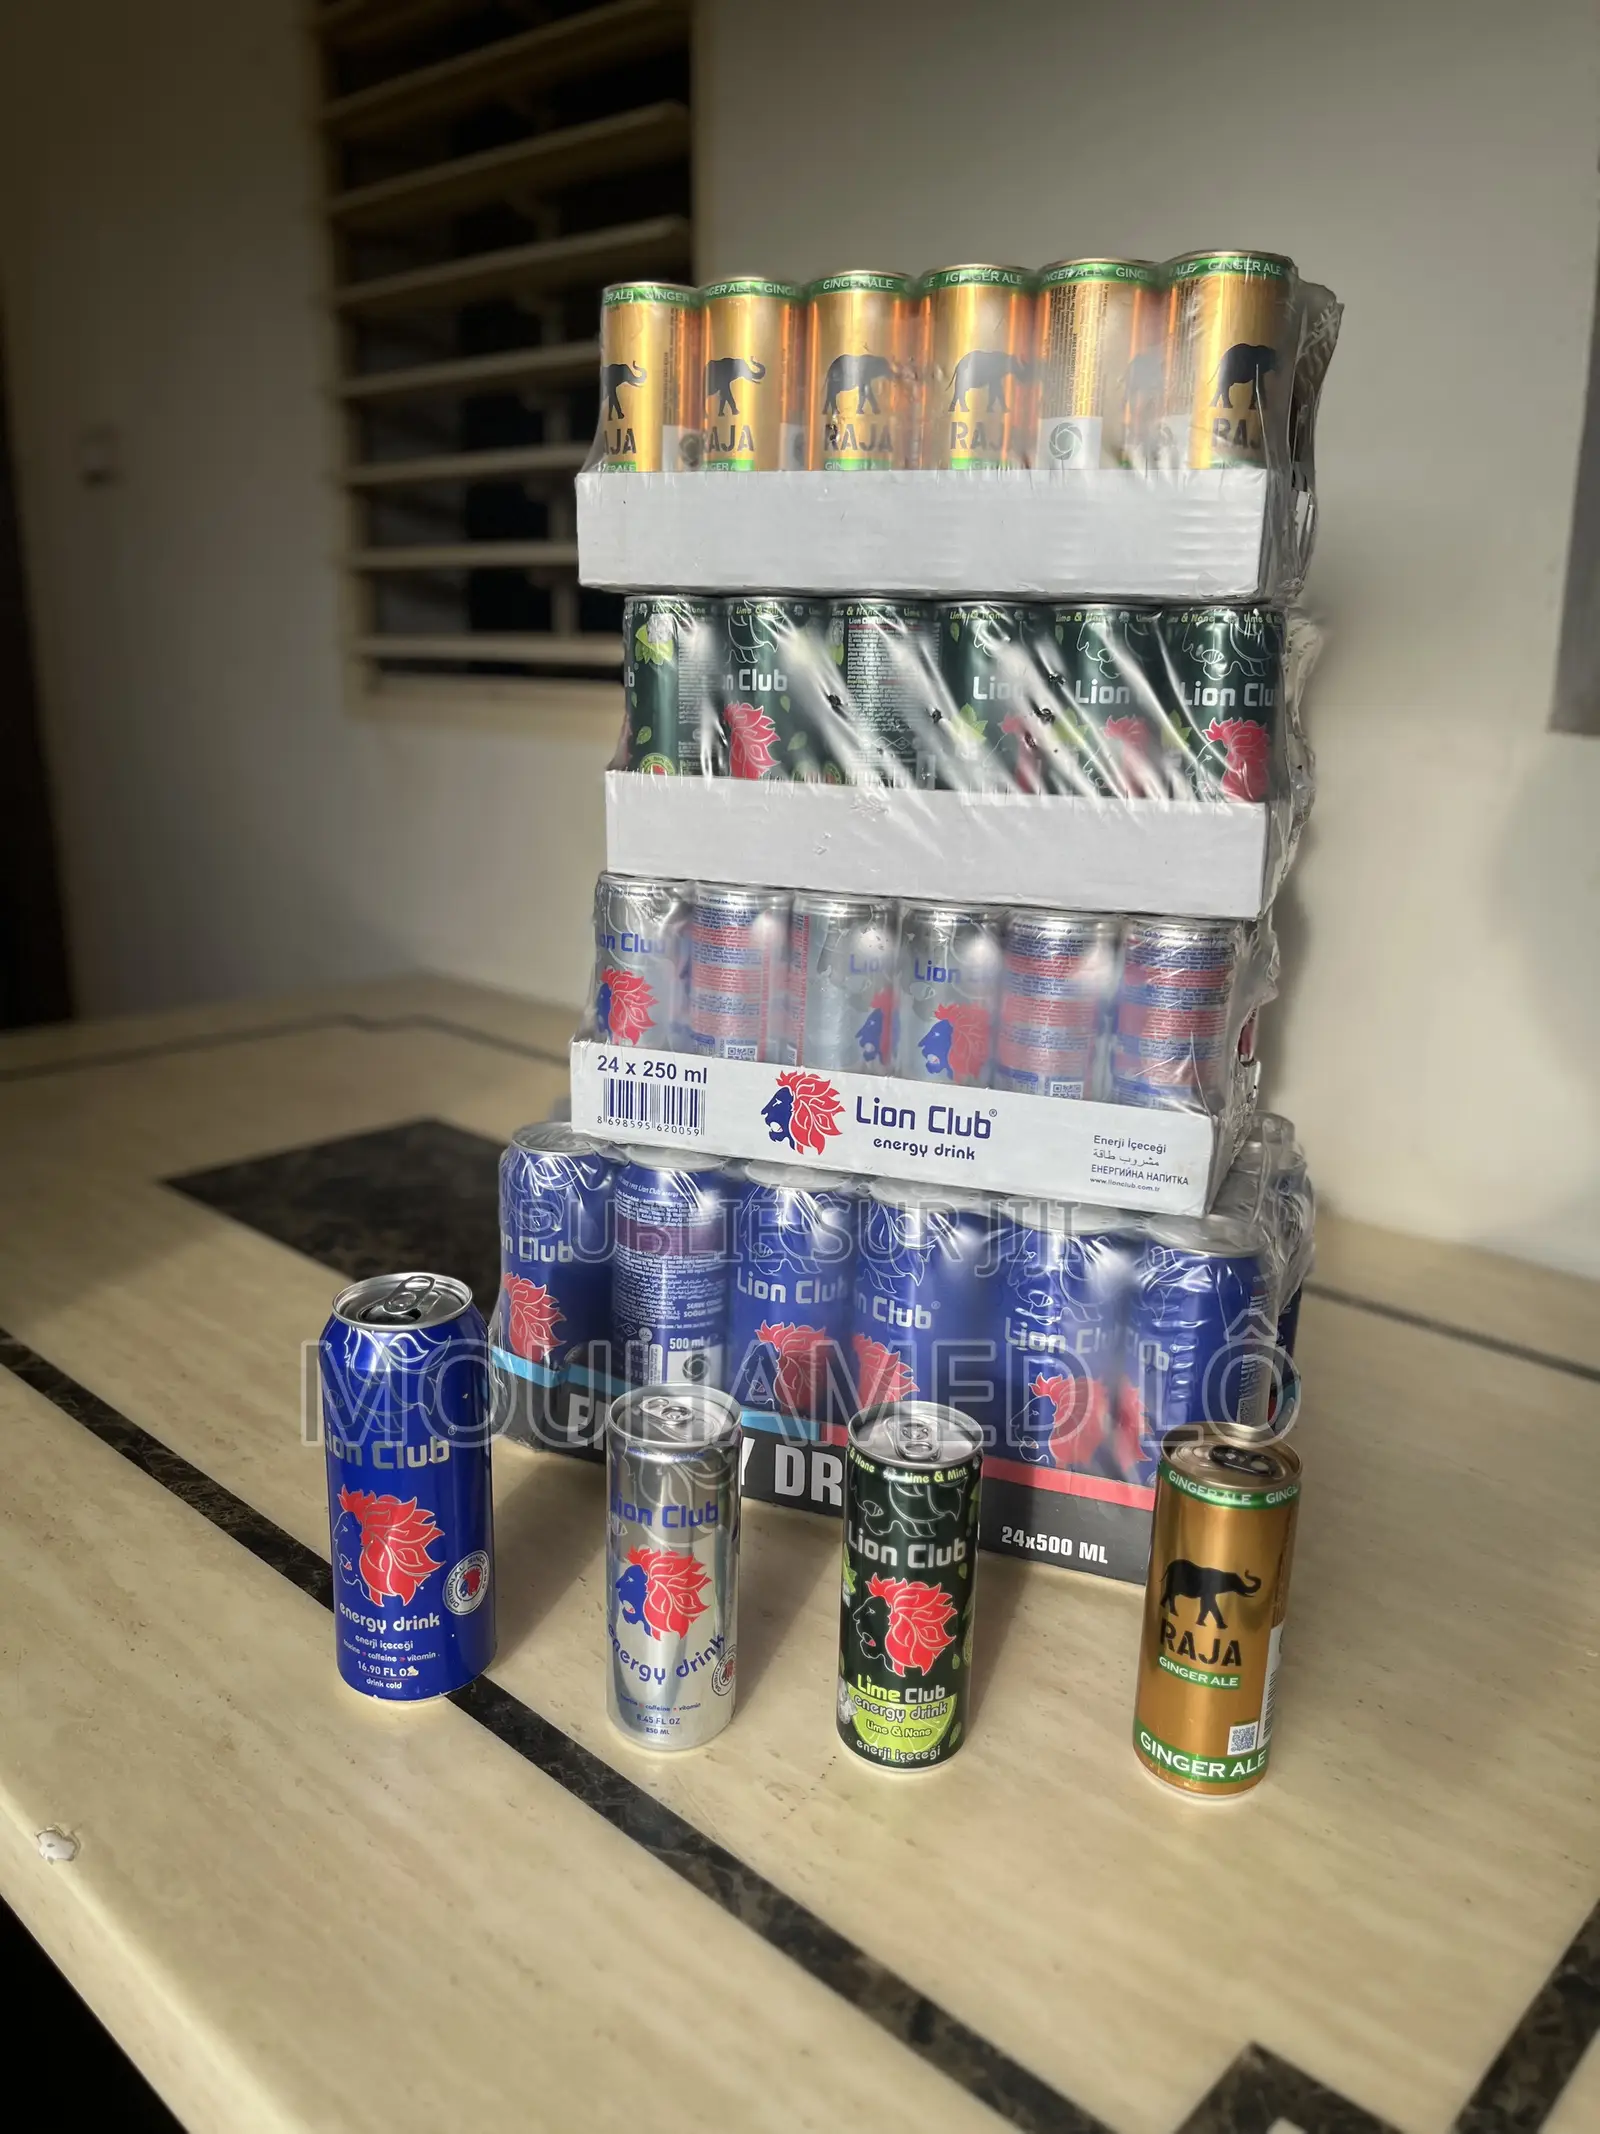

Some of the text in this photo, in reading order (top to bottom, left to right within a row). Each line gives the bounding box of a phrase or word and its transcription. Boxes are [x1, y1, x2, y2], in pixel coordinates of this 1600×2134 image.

[1208, 258, 1282, 276] GINGER ALE
[822, 276, 895, 291] GINGER ALE
[1001, 273, 1023, 286] ALE
[846, 606, 854, 616] &
[1074, 611, 1082, 622] &
[1181, 612, 1188, 622] &
[1190, 613, 1216, 623] Nane
[738, 668, 789, 692] Club
[1074, 678, 1131, 705] Lion
[1178, 680, 1277, 708] Lion Clu
[914, 957, 962, 984] Lion
[597, 1054, 708, 1084] 24 x 250 ml
[855, 1095, 916, 1131] Lion
[596, 1115, 700, 1137] 8 698595 620059
[873, 1137, 976, 1161] energy drink
[1093, 1134, 1125, 1149] Enerji
[1091, 1164, 1189, 1186] ЕНЕРГИЙНА НАПИТКА
[518, 1235, 574, 1263] Club
[736, 1266, 788, 1304] Lion
[669, 1337, 689, 1350] 500
[1005, 1316, 1067, 1355] Lion
[933, 1470, 945, 1483] &
[947, 1466, 968, 1482] Mint
[1168, 1469, 1218, 1502] GINGER
[661, 1500, 720, 1529] Club
[848, 1520, 968, 1569] Lion Club
[1001, 1525, 1109, 1565] 24x500 ML
[339, 1601, 441, 1635] energy drink
[354, 1634, 414, 1652] enerji içeceği
[607, 1623, 725, 1686] energy drink
[1159, 1618, 1243, 1667] RAJA
[357, 1660, 381, 1675] 16.90
[383, 1667, 397, 1677] FL
[367, 1652, 398, 1663] caffeine
[406, 1651, 437, 1663] vitamin
[1159, 1655, 1239, 1687] GINGER ALE
[366, 1677, 403, 1690] drink cold
[857, 1673, 946, 1704] Lime Club
[655, 1716, 667, 1725] FL
[669, 1717, 681, 1725] OZ
[854, 1694, 948, 1724] energy drink
[865, 1718, 932, 1738] Lime & Nane
[856, 1739, 942, 1763] enerji içeceği
[1139, 1730, 1266, 1779] GINGER ALE
